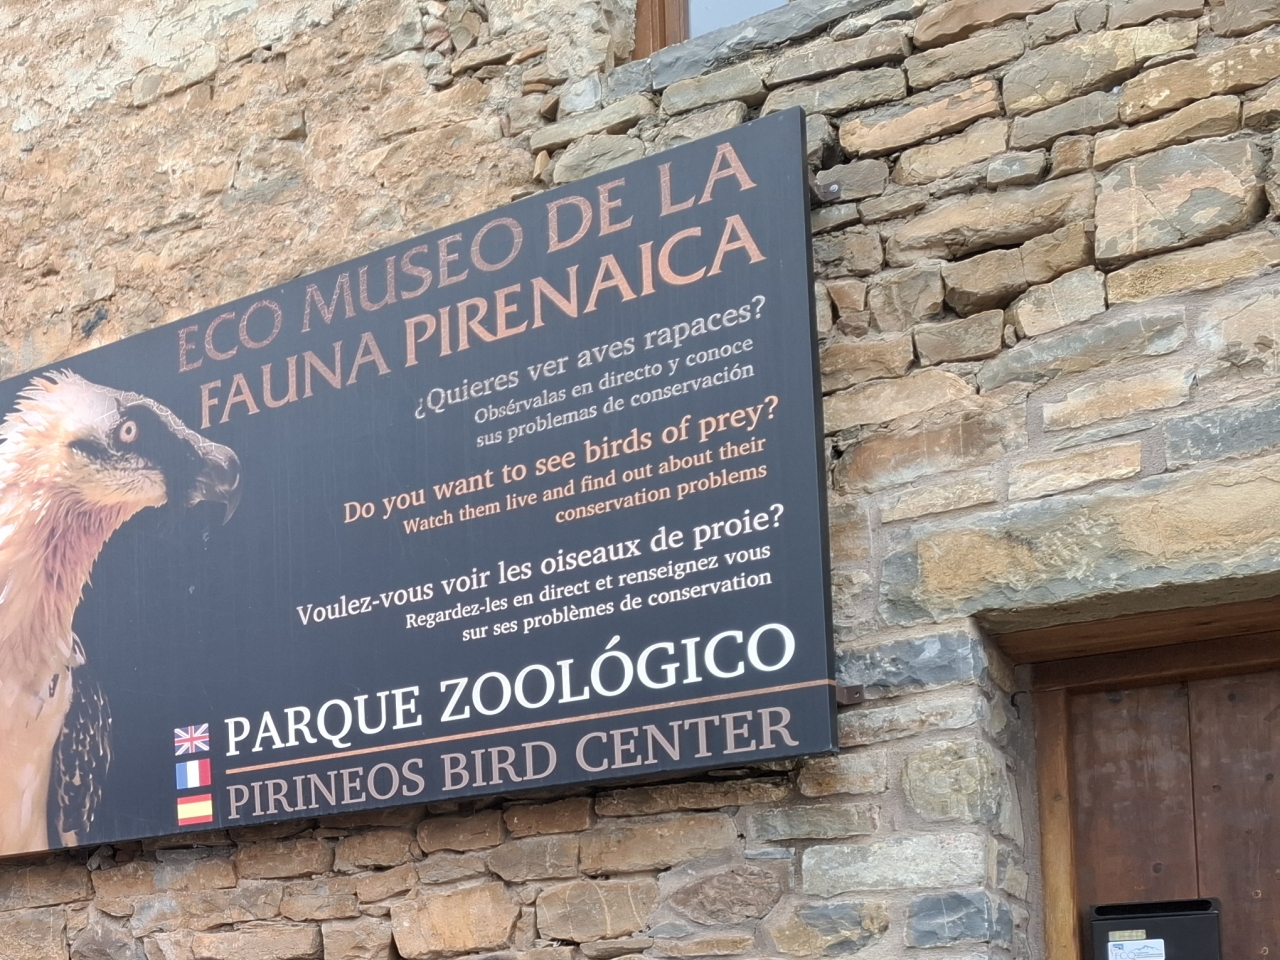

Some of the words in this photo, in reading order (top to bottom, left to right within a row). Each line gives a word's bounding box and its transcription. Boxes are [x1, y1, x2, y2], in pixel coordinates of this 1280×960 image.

[178, 300, 284, 372] ECO
[301, 217, 523, 332] MUSEO
[546, 177, 633, 253] DE
[658, 142, 757, 217] LA
[200, 332, 391, 428] FAUNA
[404, 214, 766, 367] PIRENAICA
[415, 371, 519, 419] ¿Quieres
[527, 356, 569, 381] ver
[577, 337, 635, 368] aves
[644, 295, 765, 350] rapaces?
[475, 389, 566, 423] Obsérvalas
[571, 382, 593, 397] en
[598, 364, 662, 390] directo
[668, 358, 680, 376] y
[686, 339, 753, 366] conoce
[477, 431, 502, 447] sus
[507, 406, 597, 443] problemas
[603, 396, 625, 414] de
[630, 363, 755, 406] conservación
[344, 501, 375, 523] Do
[382, 489, 426, 519] you
[433, 469, 494, 500] want
[502, 464, 527, 484] to
[535, 451, 576, 476] see
[583, 428, 652, 463] birds
[661, 414, 691, 444] of
[698, 395, 779, 443] prey?
[403, 510, 454, 534] Watch
[459, 502, 501, 521] them
[506, 493, 537, 510] live
[542, 479, 575, 502] and
[581, 469, 617, 493] find
[622, 464, 653, 483] out
[658, 449, 713, 474] about
[719, 436, 766, 460] their
[555, 487, 671, 523] conservation
[677, 465, 767, 500] problems
[296, 583, 433, 625] Voulez-vous
[441, 567, 490, 595] voir
[498, 561, 532, 584] les
[540, 539, 642, 575] oiseaux
[650, 526, 684, 552] de
[692, 503, 784, 551] proie?
[406, 597, 508, 629] Regardez-les
[513, 593, 534, 607] en
[539, 580, 590, 602] direct
[595, 575, 613, 591] et
[618, 556, 718, 587] renseignez
[724, 545, 771, 565] vous
[463, 626, 488, 641] sur
[493, 620, 518, 635] ses
[523, 602, 614, 634] problèmes
[620, 594, 642, 611] de
[647, 572, 772, 606] conservation
[224, 685, 422, 756] PARQUE
[440, 623, 795, 722] ZOOLÓGICO
[227, 758, 425, 819] PIRINEOS
[442, 741, 558, 791] BIRD
[575, 706, 799, 781] CENTER
